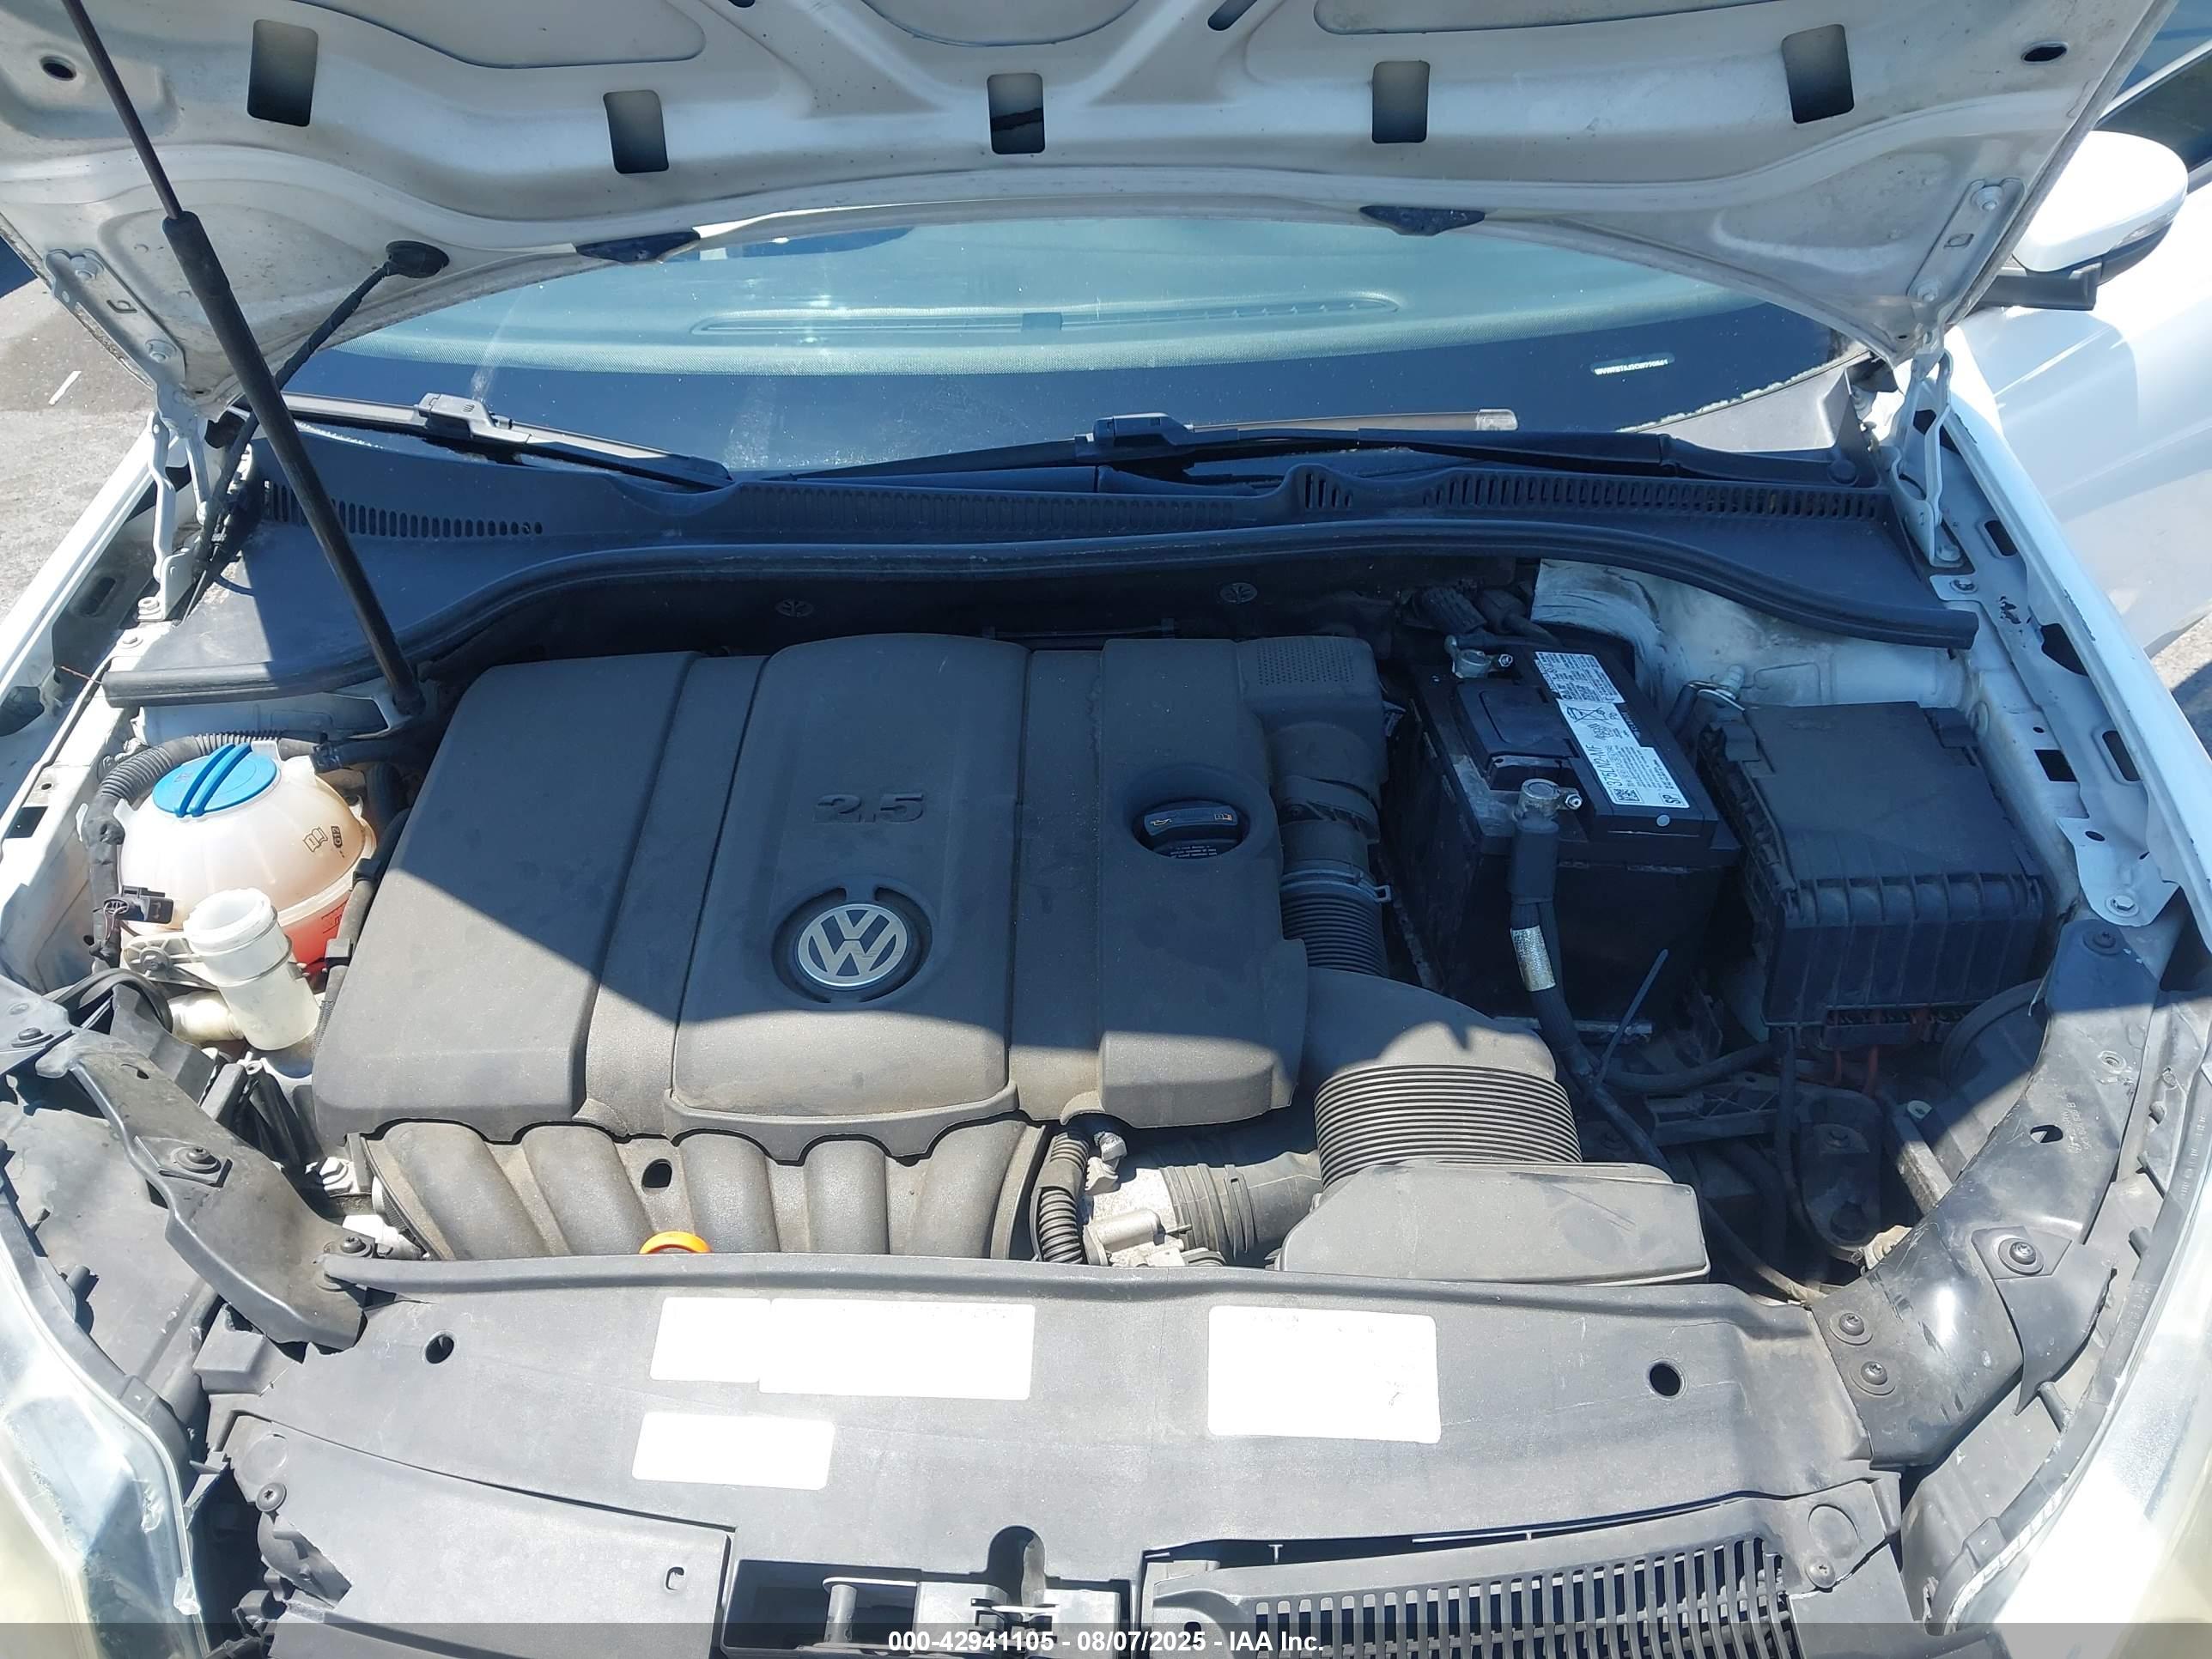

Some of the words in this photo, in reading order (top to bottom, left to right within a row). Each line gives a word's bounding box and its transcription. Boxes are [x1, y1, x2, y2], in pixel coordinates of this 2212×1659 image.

[811, 793, 925, 824] 2.5
[1662, 794, 1681, 805] SP
[798, 903, 908, 987] VW
